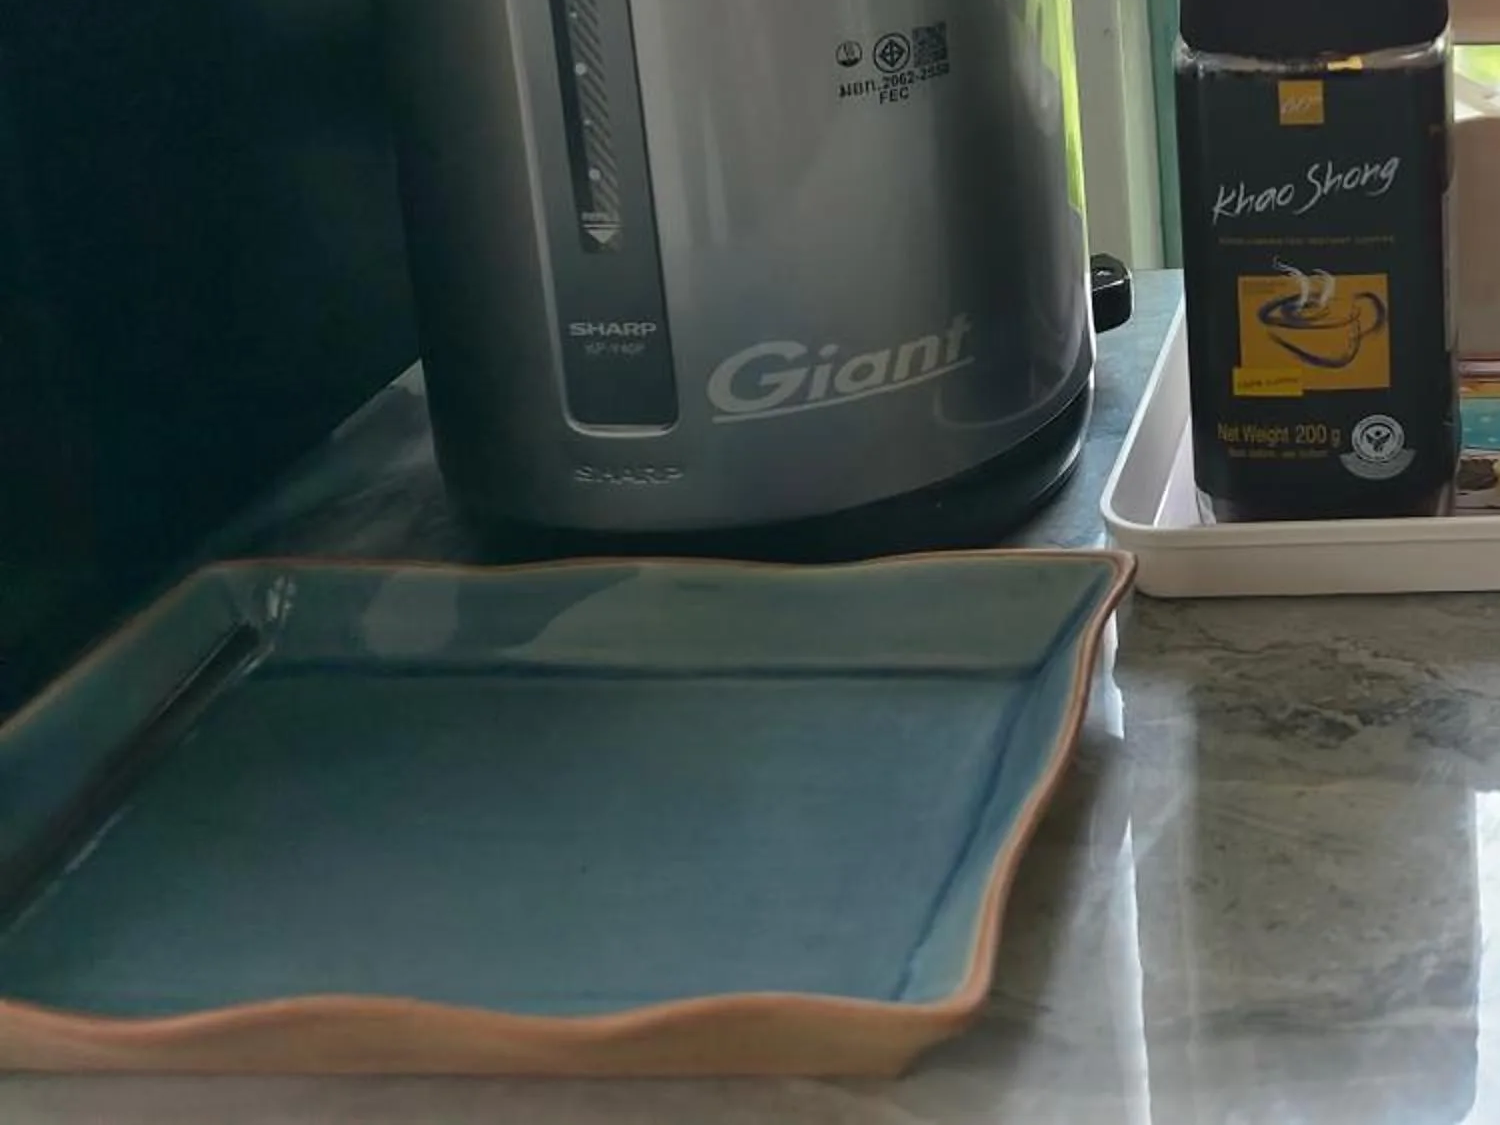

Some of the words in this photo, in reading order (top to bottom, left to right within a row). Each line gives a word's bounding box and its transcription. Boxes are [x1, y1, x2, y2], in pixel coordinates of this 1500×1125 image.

[1211, 180, 1295, 226] Khao
[1294, 156, 1403, 215] Shong
[569, 322, 657, 337] SHARP
[707, 313, 974, 414] Giant
[1217, 423, 1240, 441] Net
[1244, 423, 1290, 445] Weight
[1295, 423, 1328, 444] 200
[1331, 427, 1342, 448] g
